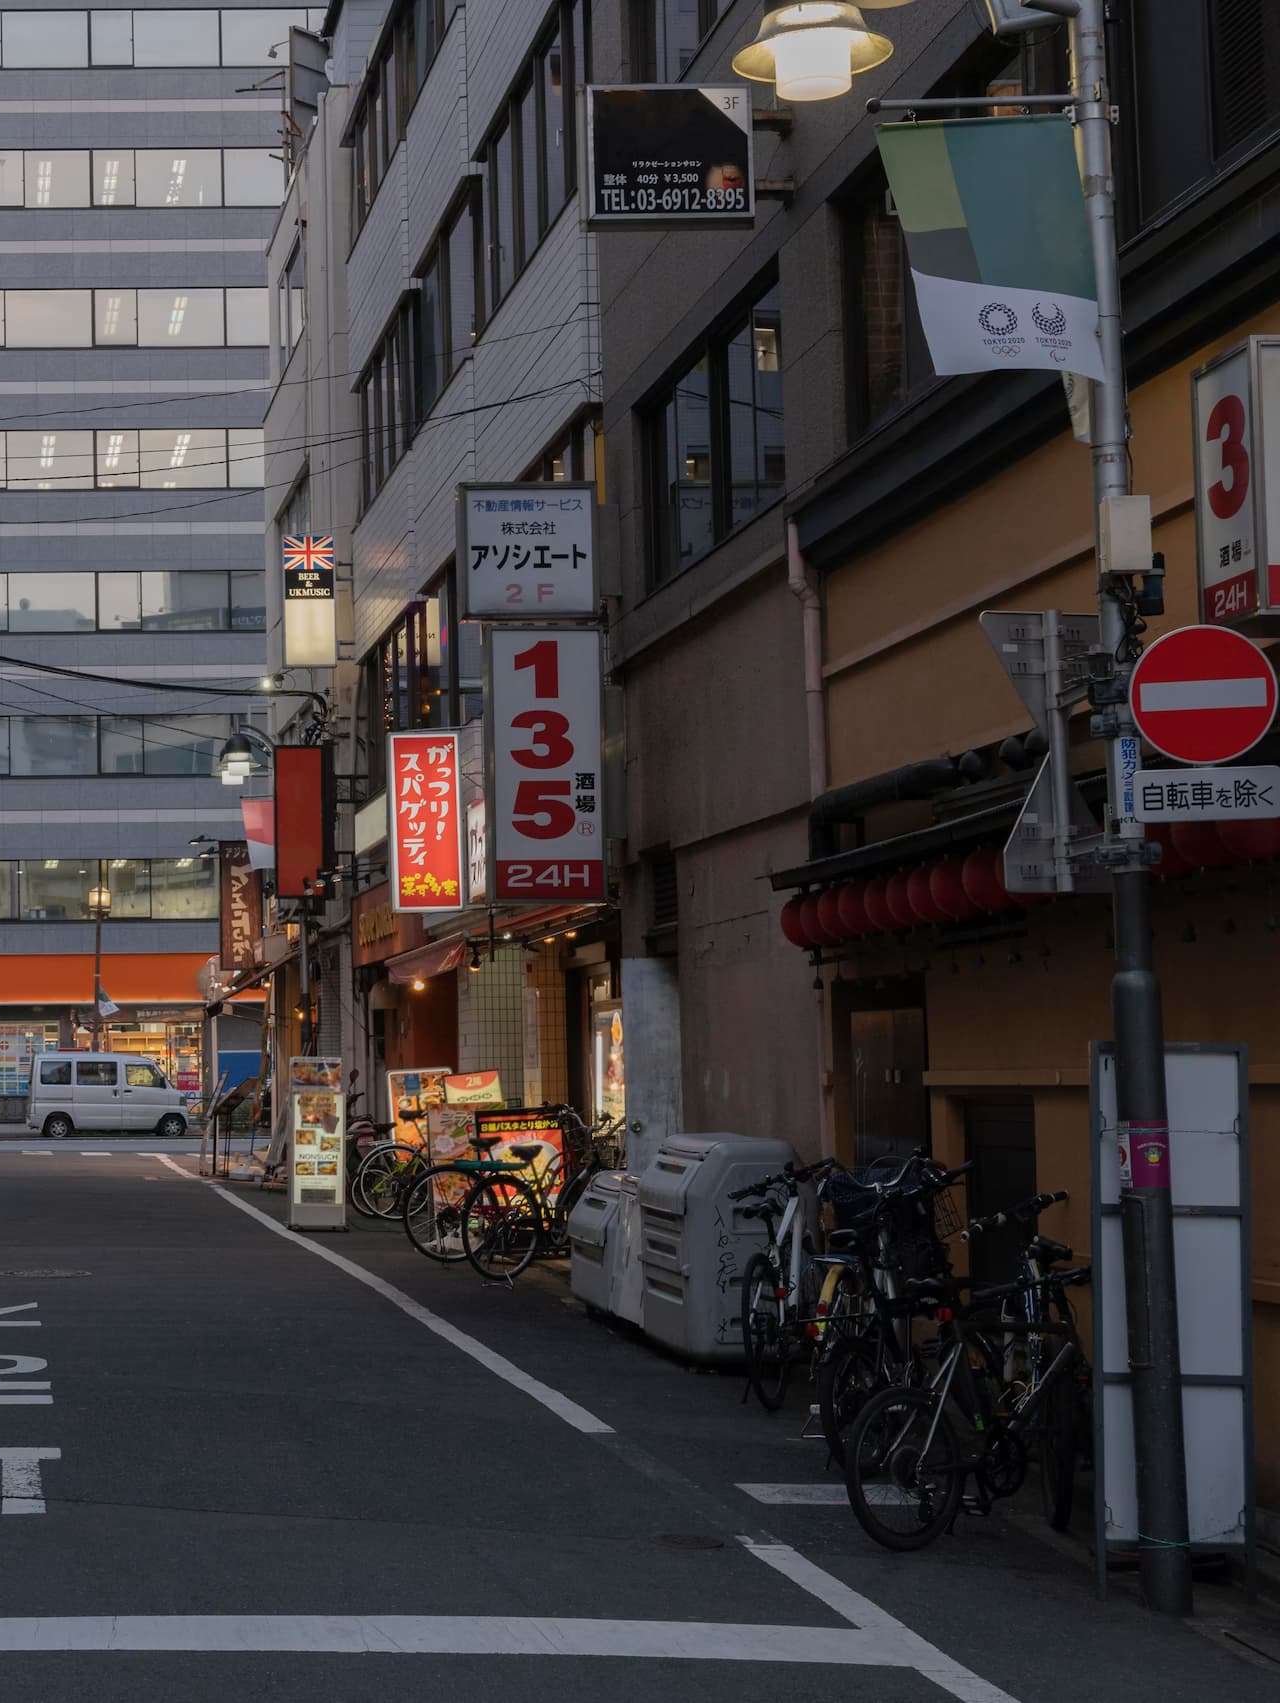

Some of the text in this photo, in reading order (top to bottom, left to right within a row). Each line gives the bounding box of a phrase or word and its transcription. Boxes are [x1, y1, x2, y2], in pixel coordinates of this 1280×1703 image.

[723, 96, 740, 110] 3F
[636, 174, 659, 184] 40分
[1035, 337, 1058, 345] TOKYO
[1206, 394, 1250, 520] 3
[472, 498, 584, 513] 不動産情報サービス
[501, 521, 557, 535] 株式会社
[471, 543, 587, 571] アソシエート
[298, 572, 320, 581] BEER
[505, 583, 555, 604] 2F
[1214, 579, 1248, 618] 24H
[575, 772, 596, 813] 酒場
[1142, 778, 1274, 811] 自転車を除く
[399, 753, 427, 866] スパゲッティ
[507, 863, 590, 888] 24H
[298, 1153, 338, 1161] NONSUCH
